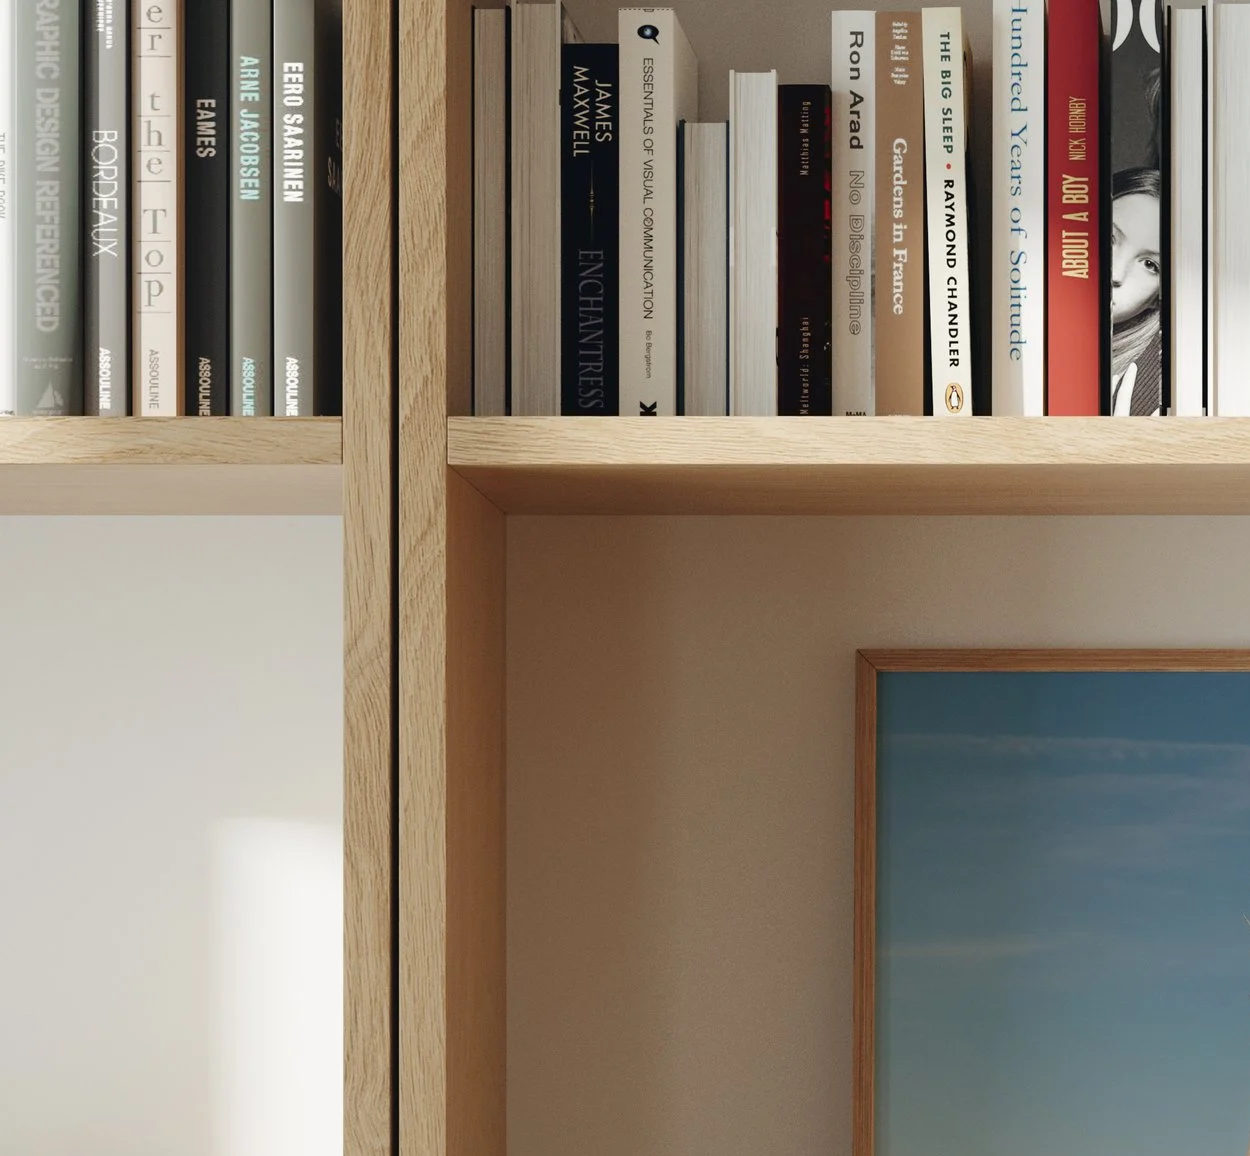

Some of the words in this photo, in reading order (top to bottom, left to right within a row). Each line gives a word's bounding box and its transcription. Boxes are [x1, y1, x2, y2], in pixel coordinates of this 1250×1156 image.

[849, 31, 864, 80] Ron
[940, 32, 950, 62] THE
[240, 56, 260, 101] ARNE
[283, 62, 304, 106] EERO
[642, 58, 654, 134] ESSENTIALS
[941, 70, 952, 99] BIG
[36, 88, 60, 172] DESIGN
[197, 99, 215, 158] EAMES
[573, 66, 590, 157] MAXWELL
[595, 80, 612, 142] JAMES
[800, 102, 810, 133] Matting
[849, 90, 864, 149] Arad
[942, 107, 954, 154] SLEEP
[1070, 96, 1086, 131] HORNBY
[240, 110, 260, 200] JACOBSEN
[283, 113, 304, 201] SAARINEN
[642, 138, 654, 155] OF
[800, 136, 810, 176] Matthias
[1010, 123, 1028, 197] Years
[1070, 134, 1086, 160] NICK
[91, 130, 118, 257] BORDEAUX
[642, 159, 654, 204] VISUAL
[849, 171, 864, 204] No
[893, 138, 908, 218] Gardens
[1062, 174, 1089, 204] BOY
[893, 223, 908, 243] in
[944, 180, 957, 269] RAYMOND
[1010, 210, 1028, 238] of
[1062, 211, 1089, 222] A
[36, 180, 60, 333] REFERENCED
[642, 208, 654, 319] COMMUNICATION
[846, 215, 864, 335] Discipline
[893, 248, 908, 315] France
[1062, 229, 1089, 278] ABOUT
[579, 249, 604, 408] ENCHANTRESS
[947, 277, 959, 367] CHANDLER
[1010, 250, 1028, 361] Solitude
[800, 317, 810, 360] Shanghai
[99, 347, 111, 410] ASSOULINE
[800, 363, 810, 416] Meltworld:
